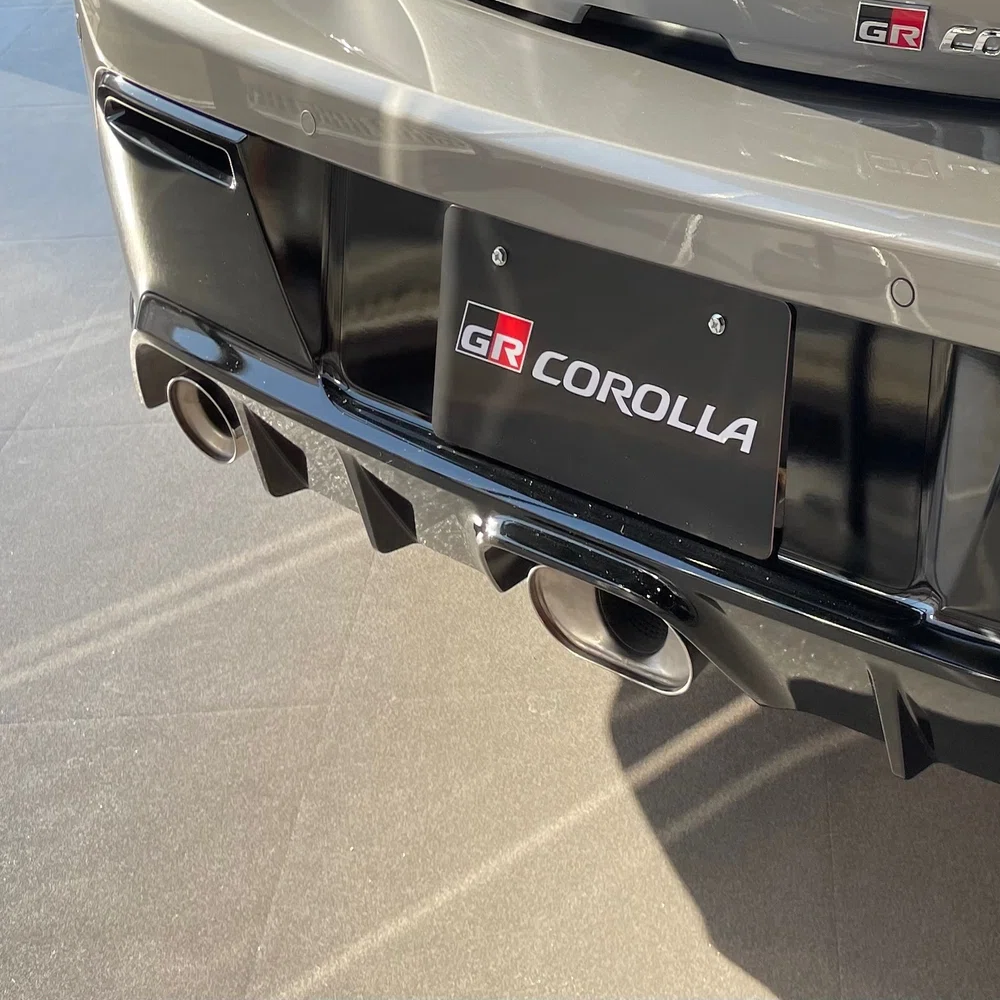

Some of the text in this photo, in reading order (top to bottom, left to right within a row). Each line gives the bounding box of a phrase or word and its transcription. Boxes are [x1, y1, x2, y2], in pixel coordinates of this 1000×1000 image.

[859, 21, 922, 47] GR
[460, 324, 758, 454] GR COROLLA
